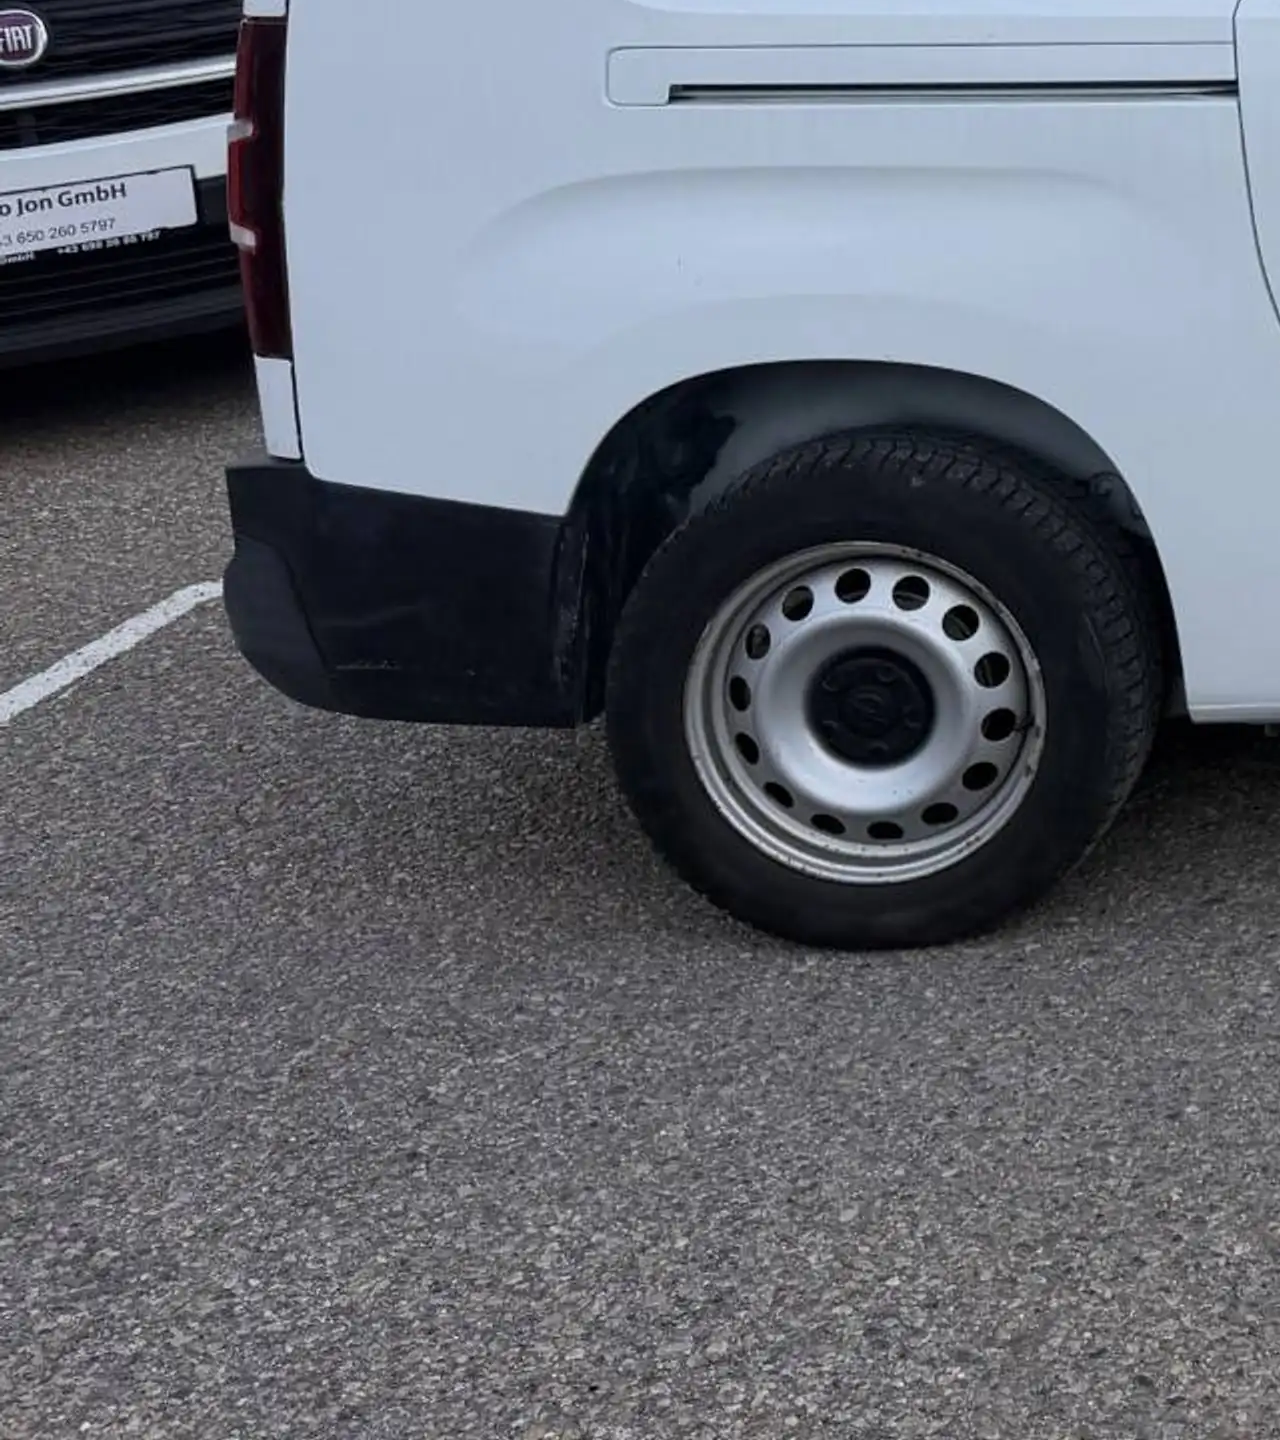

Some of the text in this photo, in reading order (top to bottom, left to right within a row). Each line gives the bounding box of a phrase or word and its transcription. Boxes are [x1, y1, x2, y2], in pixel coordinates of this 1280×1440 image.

[17, 197, 53, 217] Jon
[58, 182, 127, 208] GmbH
[16, 230, 45, 244] 650
[50, 224, 76, 240] 260
